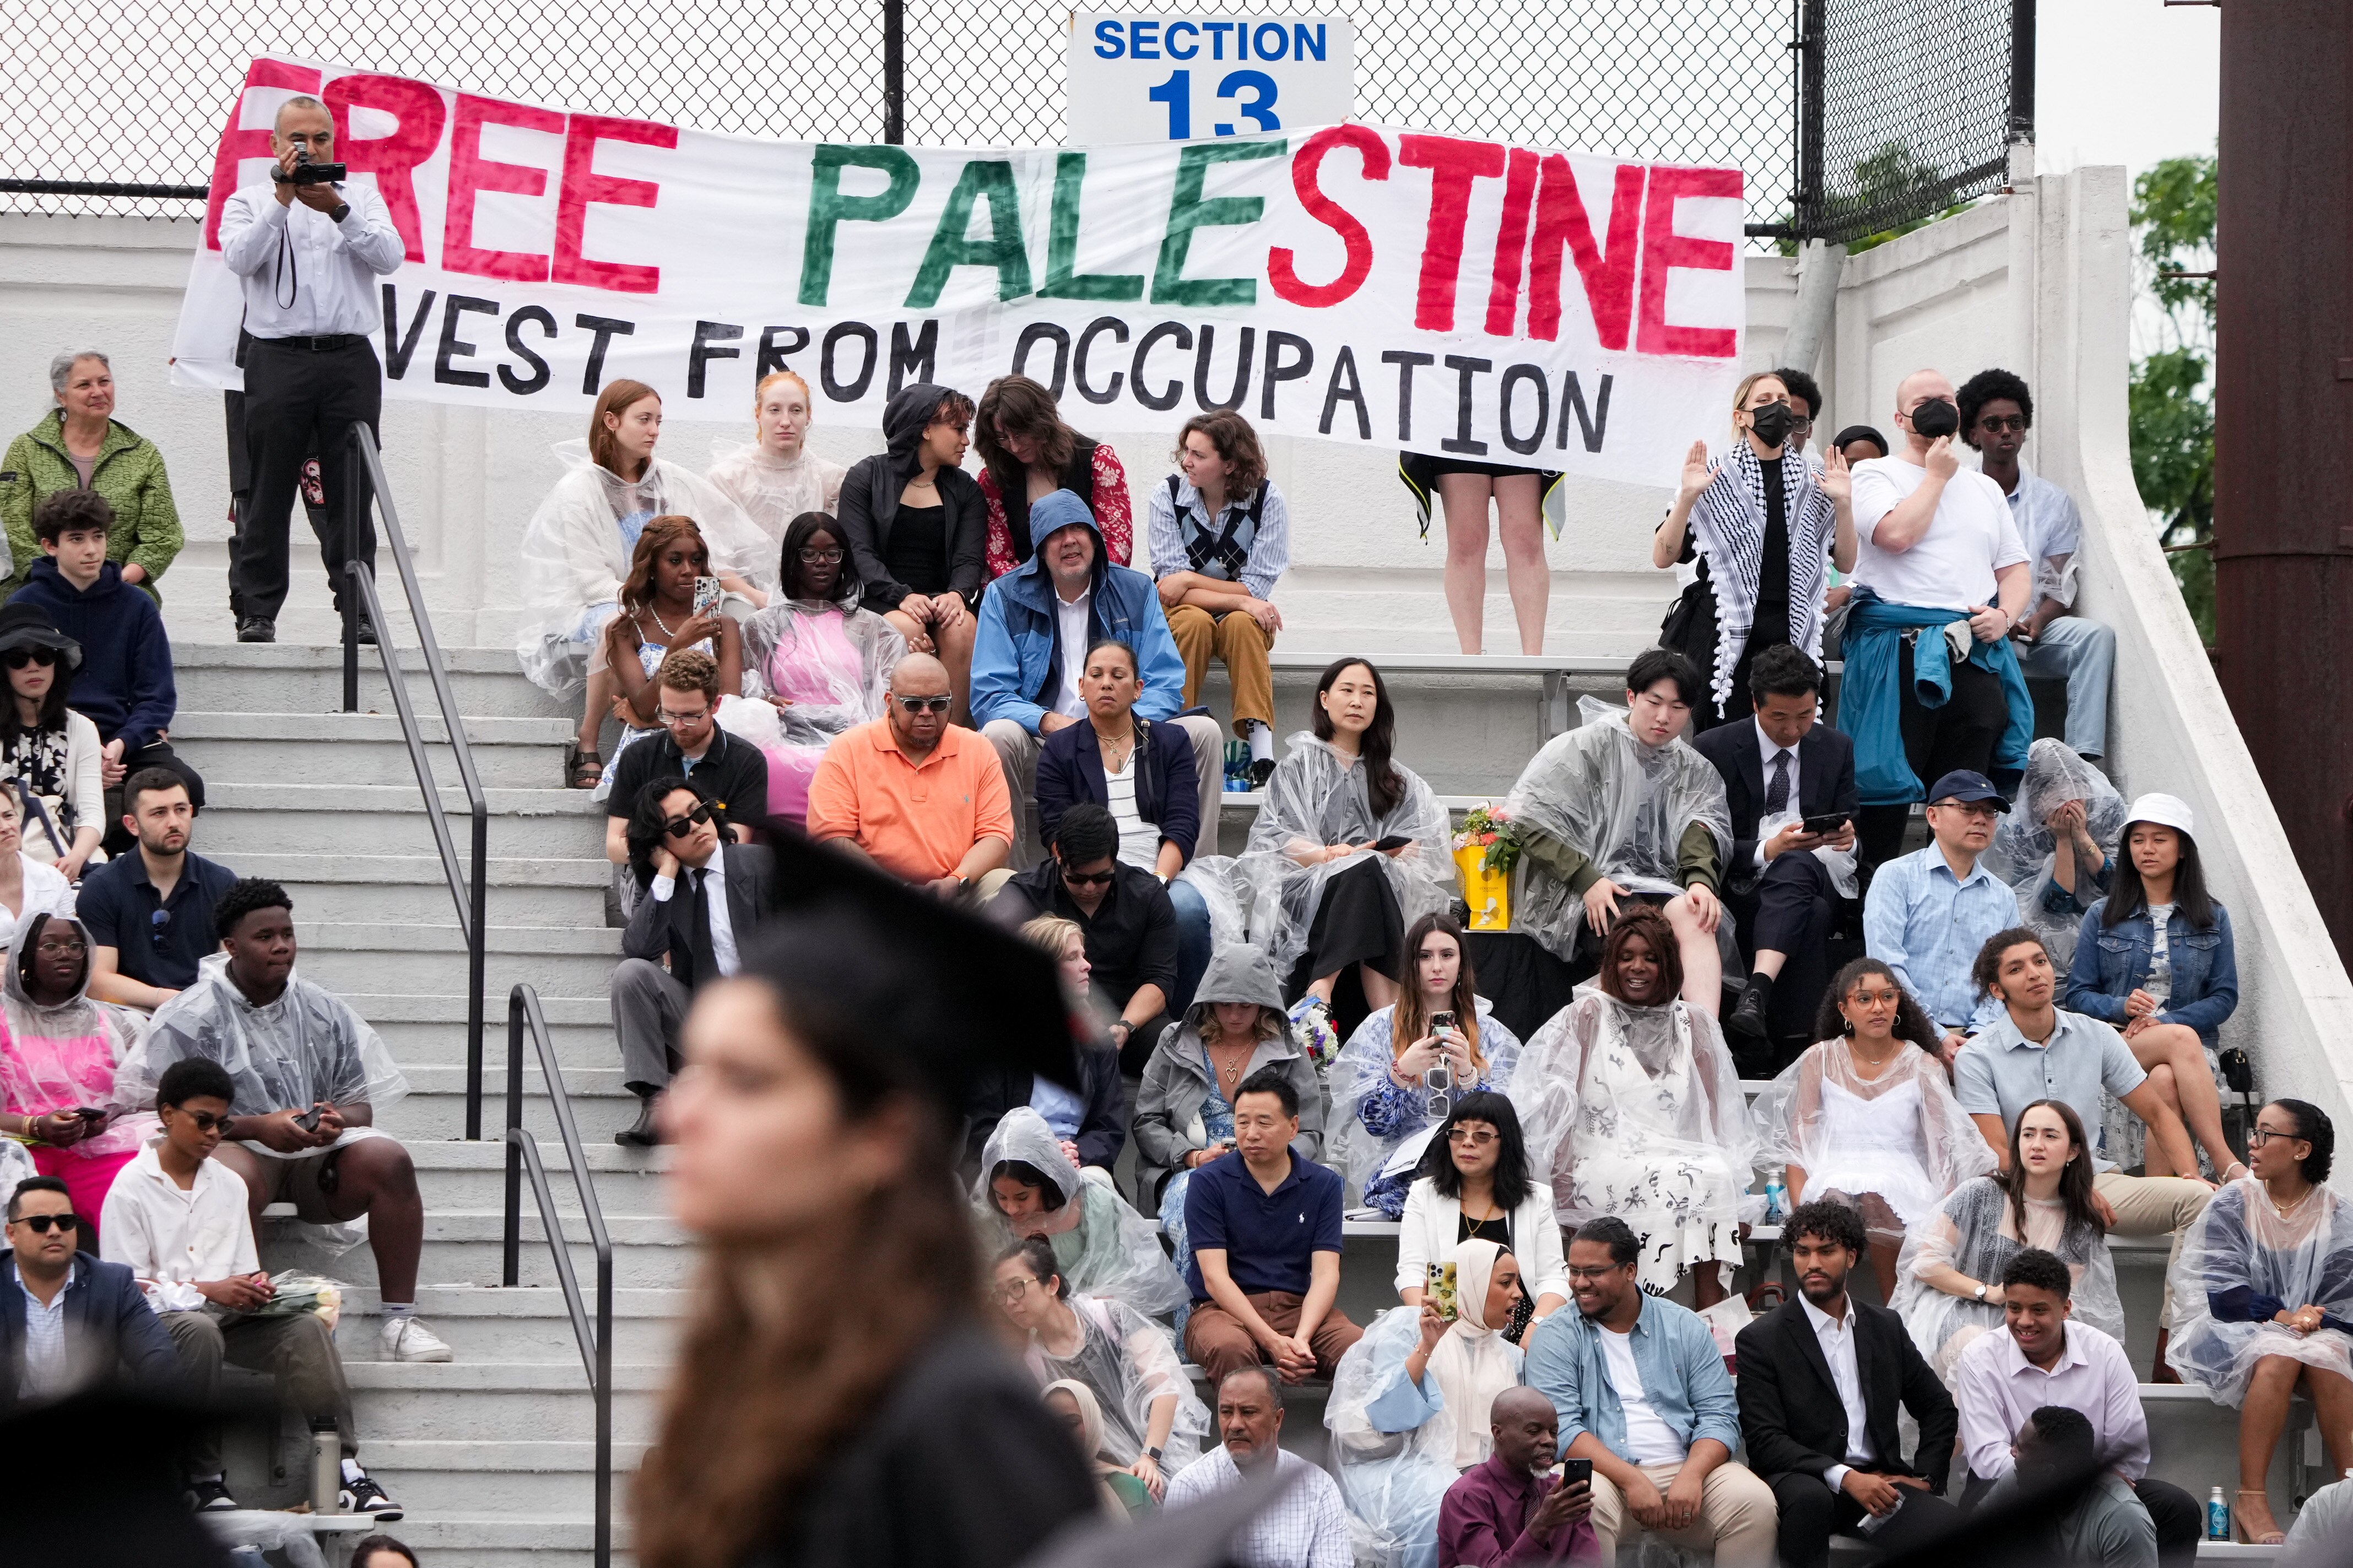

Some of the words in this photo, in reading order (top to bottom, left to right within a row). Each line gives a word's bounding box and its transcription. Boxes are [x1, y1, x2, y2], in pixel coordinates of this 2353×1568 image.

[1094, 20, 1326, 62] SECTION
[1149, 69, 1281, 140] 13
[205, 58, 679, 294] FREE
[798, 123, 1744, 358] PALESTINE
[236, 283, 635, 396] VEST
[687, 319, 938, 403] FROM
[1011, 316, 1613, 456] OCCUPATION
